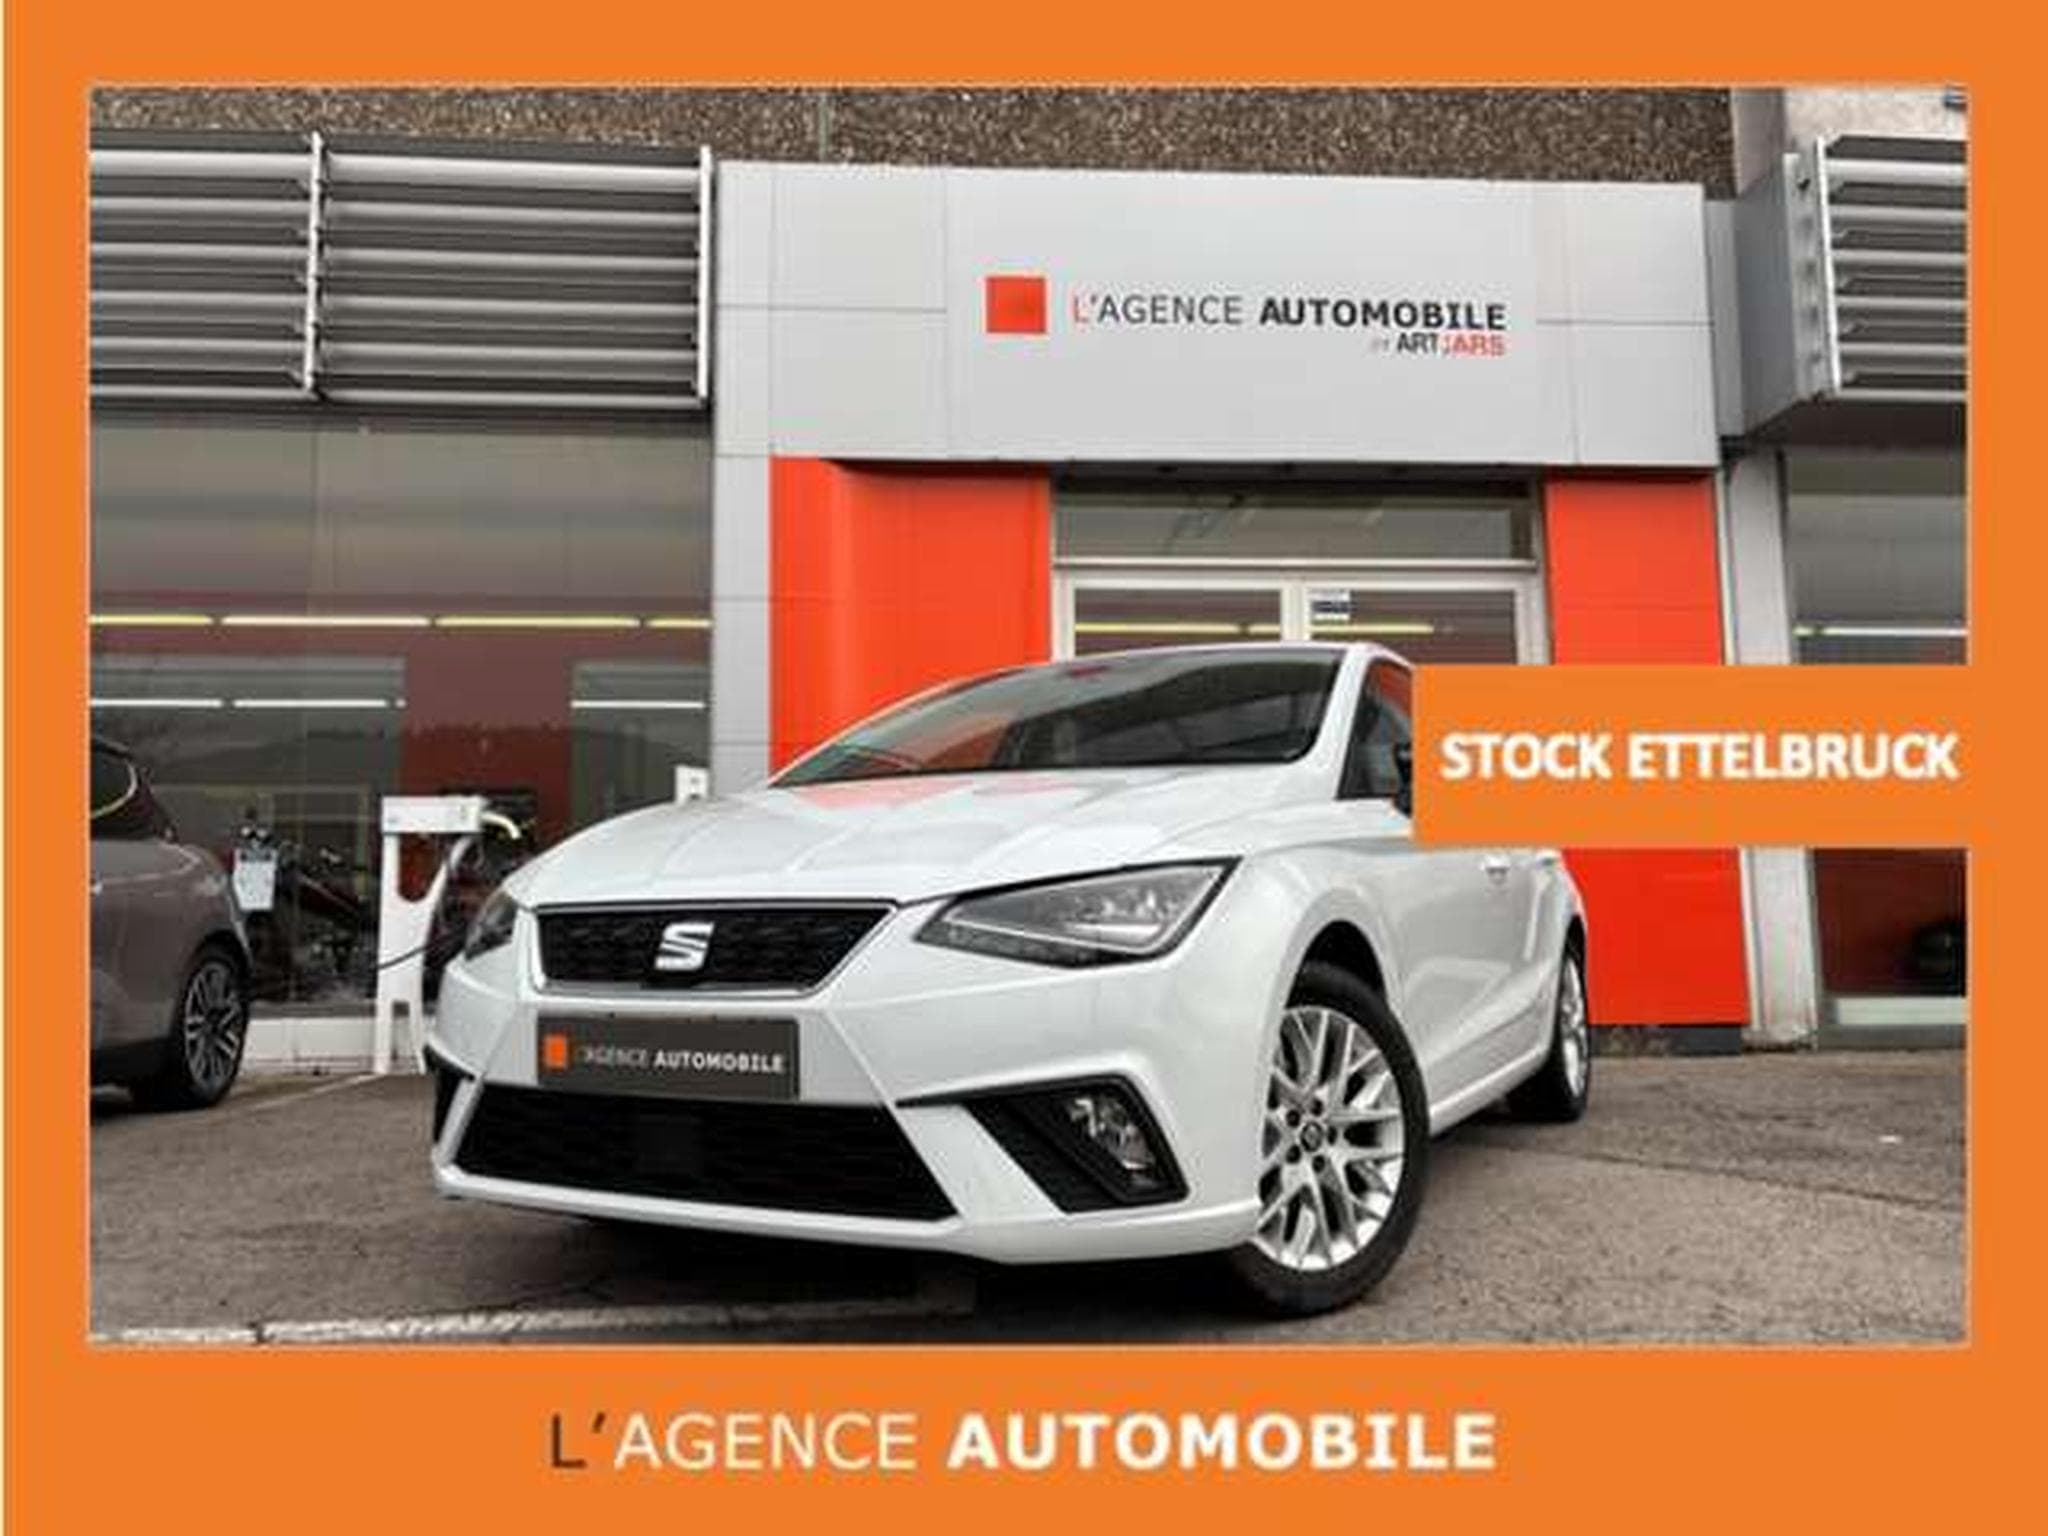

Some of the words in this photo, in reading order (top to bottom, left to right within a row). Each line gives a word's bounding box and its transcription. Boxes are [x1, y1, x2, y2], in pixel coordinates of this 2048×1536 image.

[1071, 295, 1244, 325] L'AGENCE
[1259, 297, 1507, 330] AUTOMOBILE
[574, 1047, 648, 1069] AGENCE
[652, 1050, 785, 1075] AUTOMOBILE
